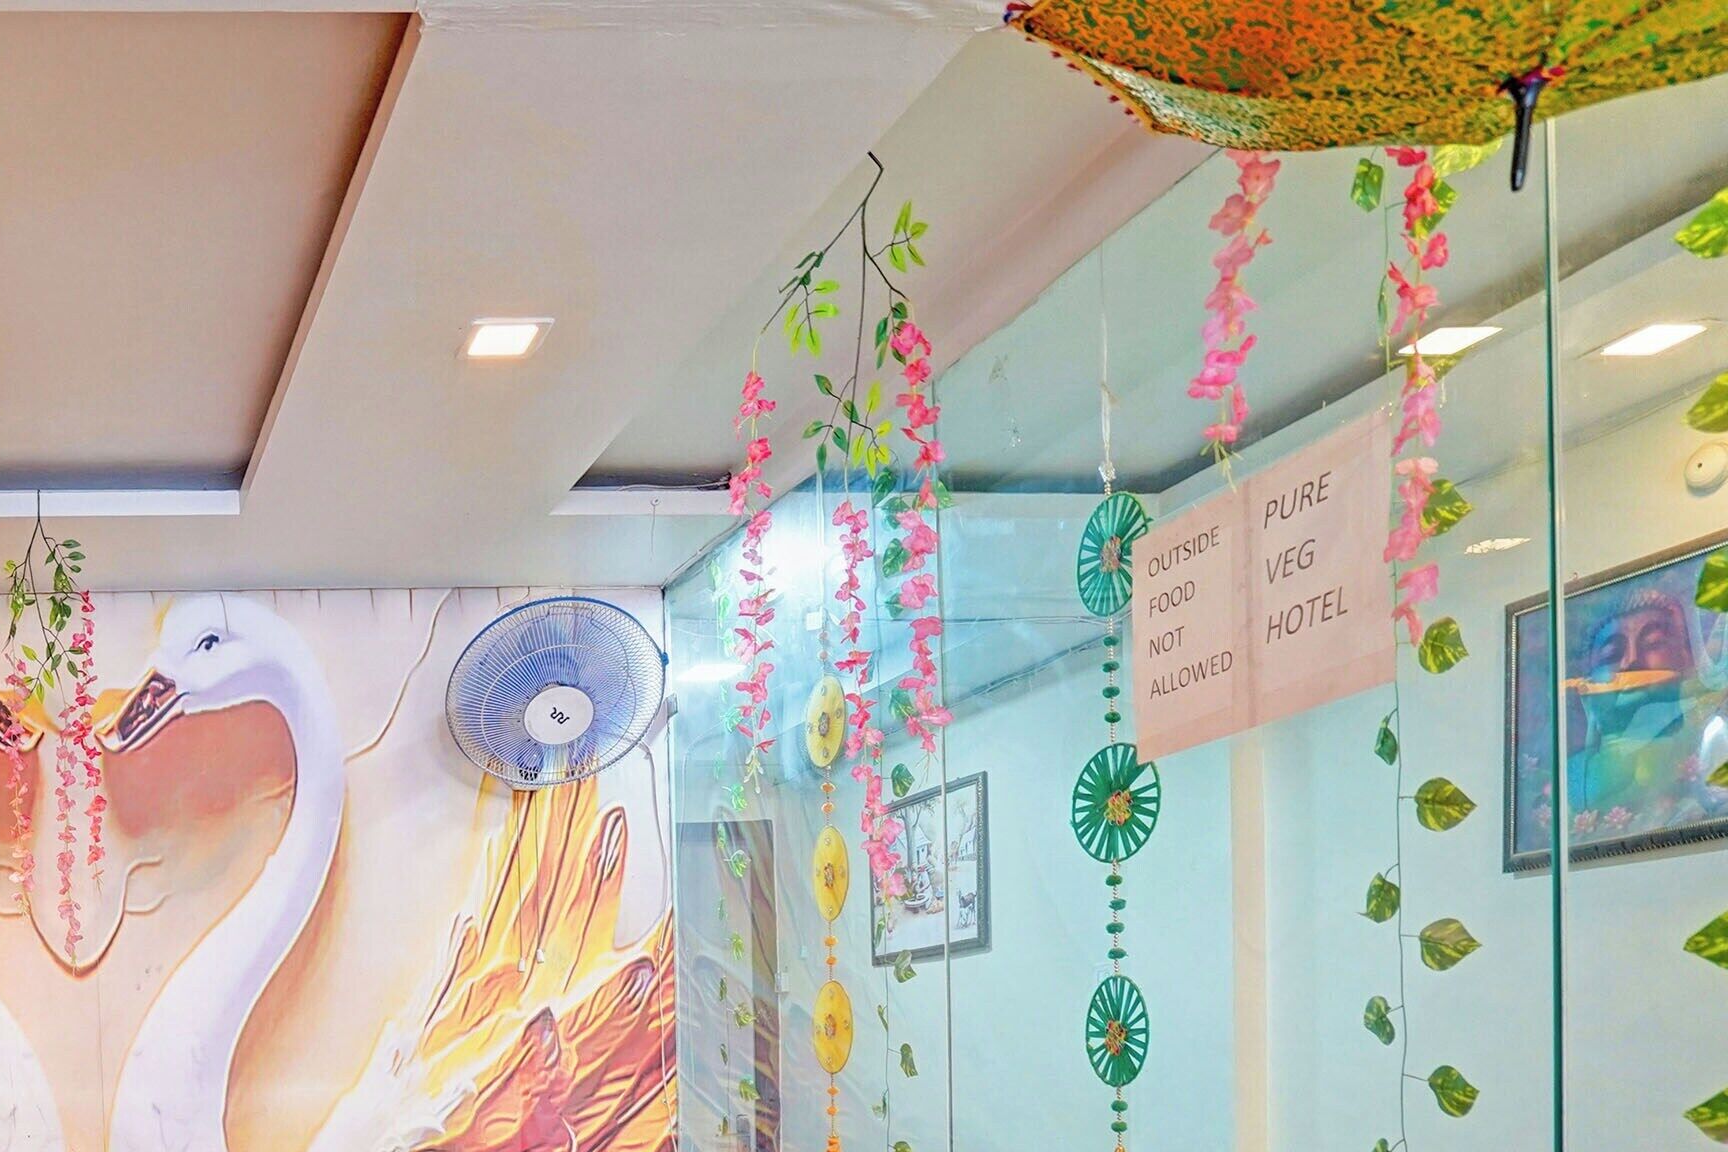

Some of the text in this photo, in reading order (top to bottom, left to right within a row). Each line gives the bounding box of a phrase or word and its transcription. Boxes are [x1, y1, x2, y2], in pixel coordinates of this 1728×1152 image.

[1264, 471, 1331, 529] PURE
[1148, 525, 1221, 578] OUTSIDE
[1265, 538, 1316, 585] VEG
[1148, 580, 1196, 618] FOOD
[1266, 586, 1348, 644] HOTEL
[1148, 626, 1185, 658] NOT
[1149, 650, 1233, 699] ALLOWED
